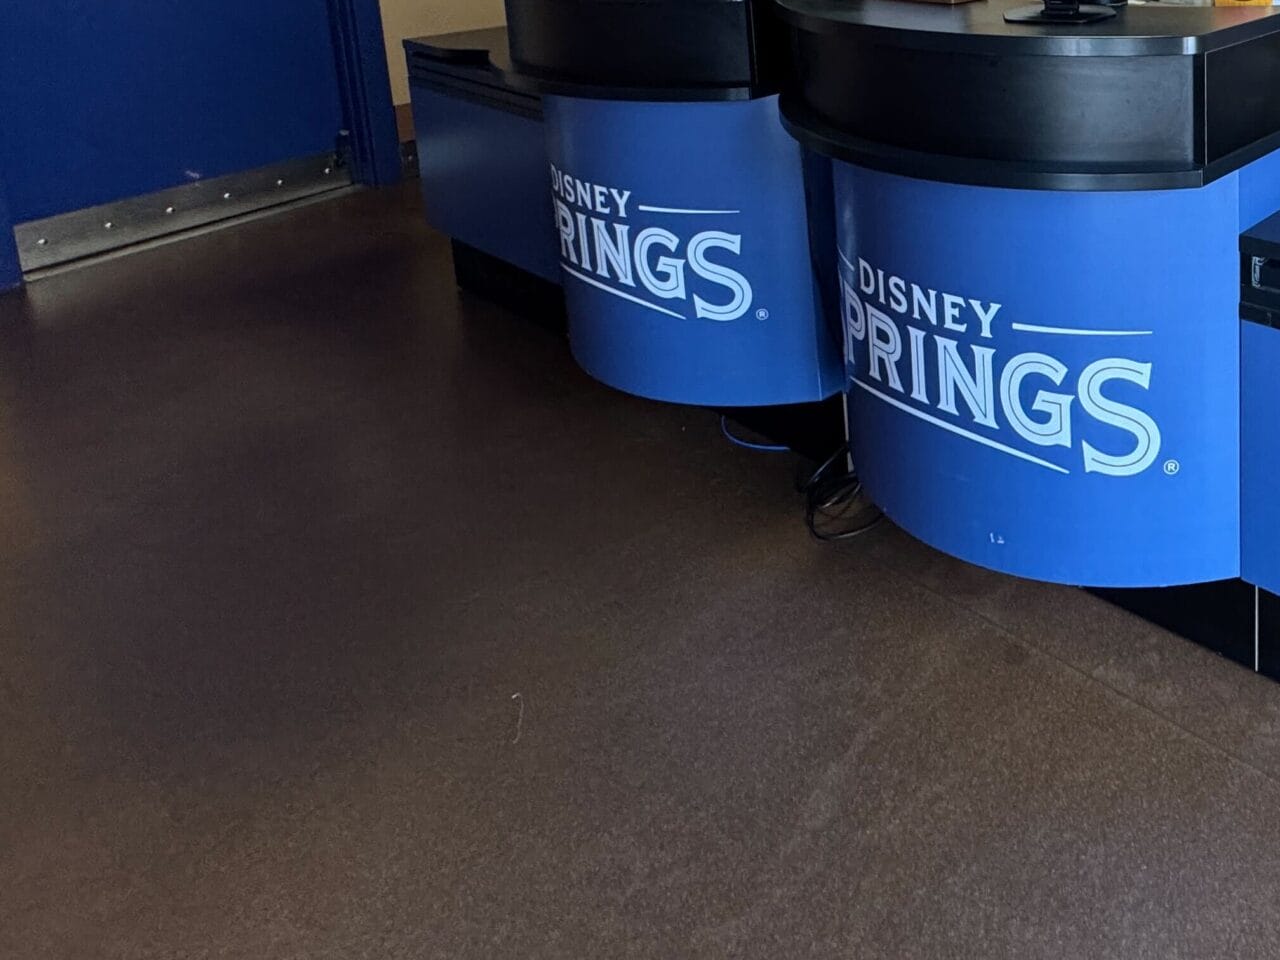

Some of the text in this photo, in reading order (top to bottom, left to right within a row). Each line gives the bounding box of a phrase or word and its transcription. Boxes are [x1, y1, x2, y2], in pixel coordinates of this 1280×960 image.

[551, 162, 631, 218] DISNEY
[551, 190, 753, 321] RINGS
[858, 256, 1002, 338] DISNEY
[838, 266, 1161, 476] PRINGS
